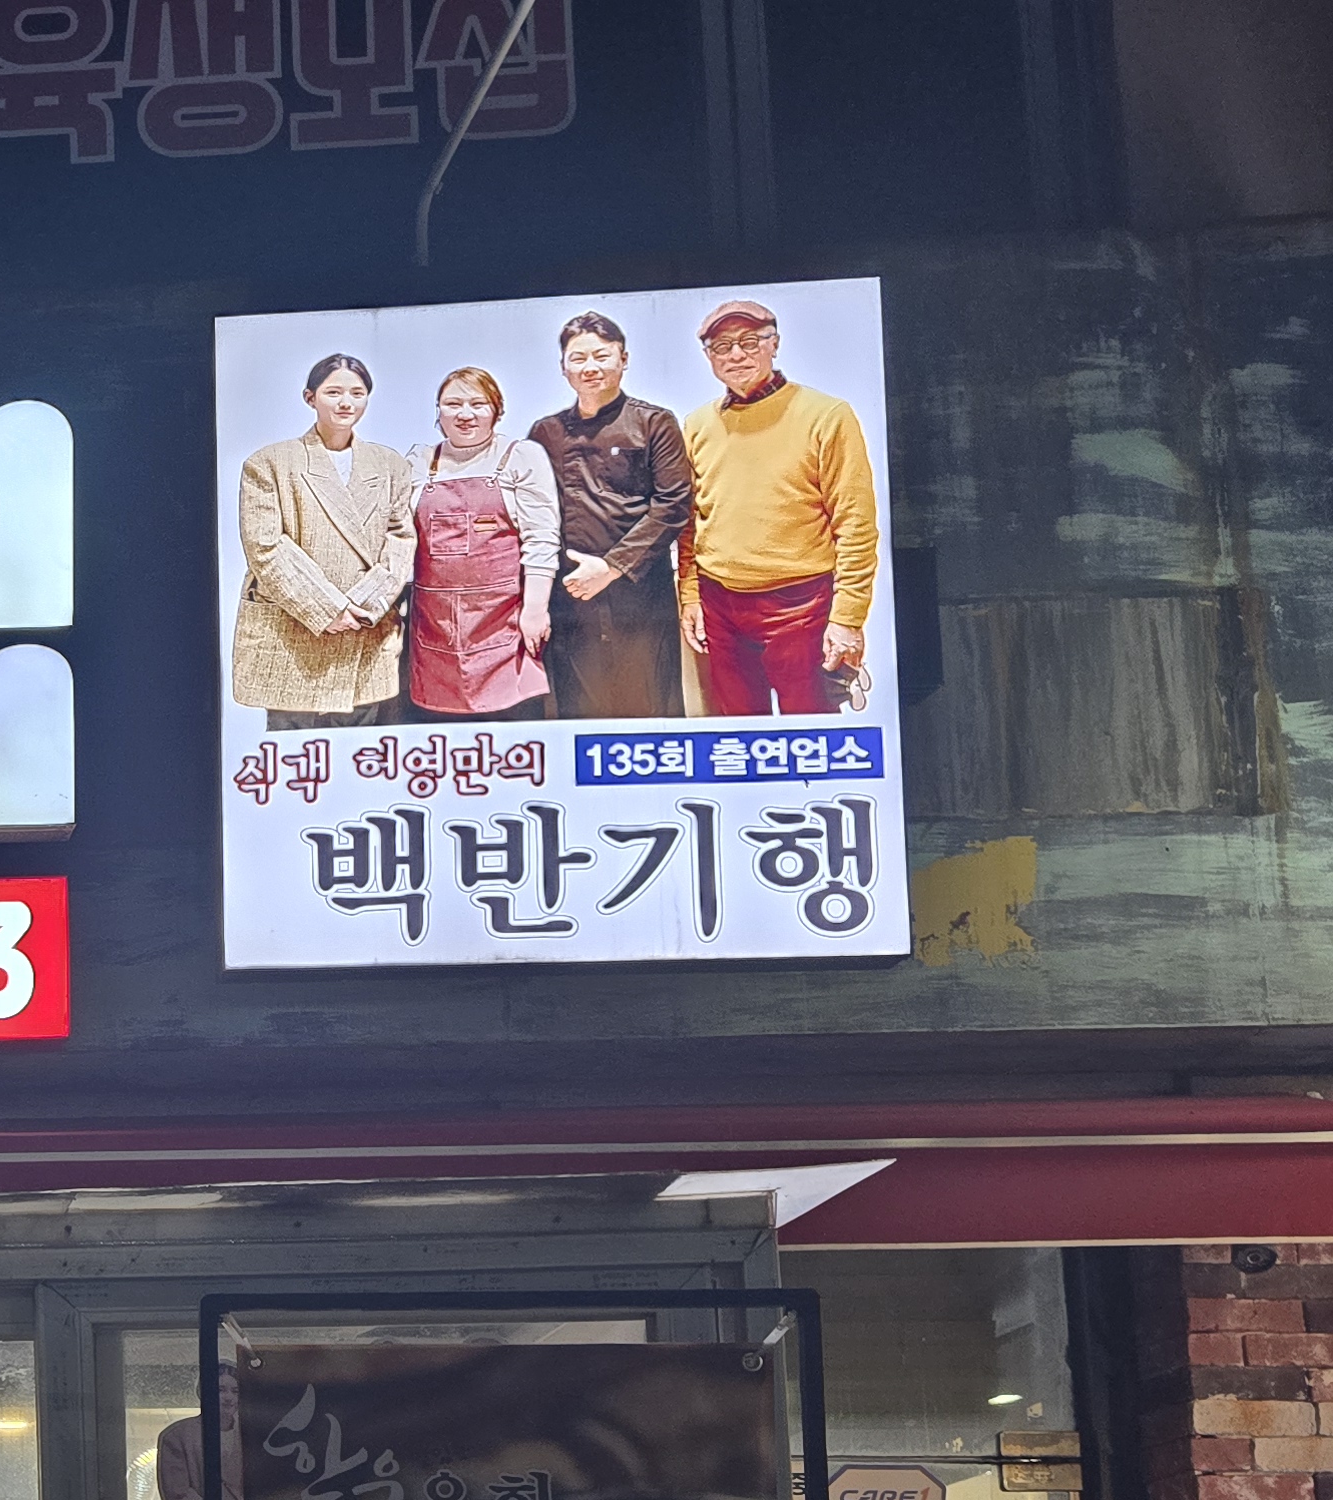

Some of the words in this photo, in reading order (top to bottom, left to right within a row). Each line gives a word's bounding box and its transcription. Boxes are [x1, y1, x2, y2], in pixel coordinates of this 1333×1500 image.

[232, 738, 331, 804] 식객
[353, 733, 546, 798] 허영만의
[584, 737, 696, 778] 135회
[710, 734, 873, 775] 출연업소
[301, 794, 878, 945] 백반기행
